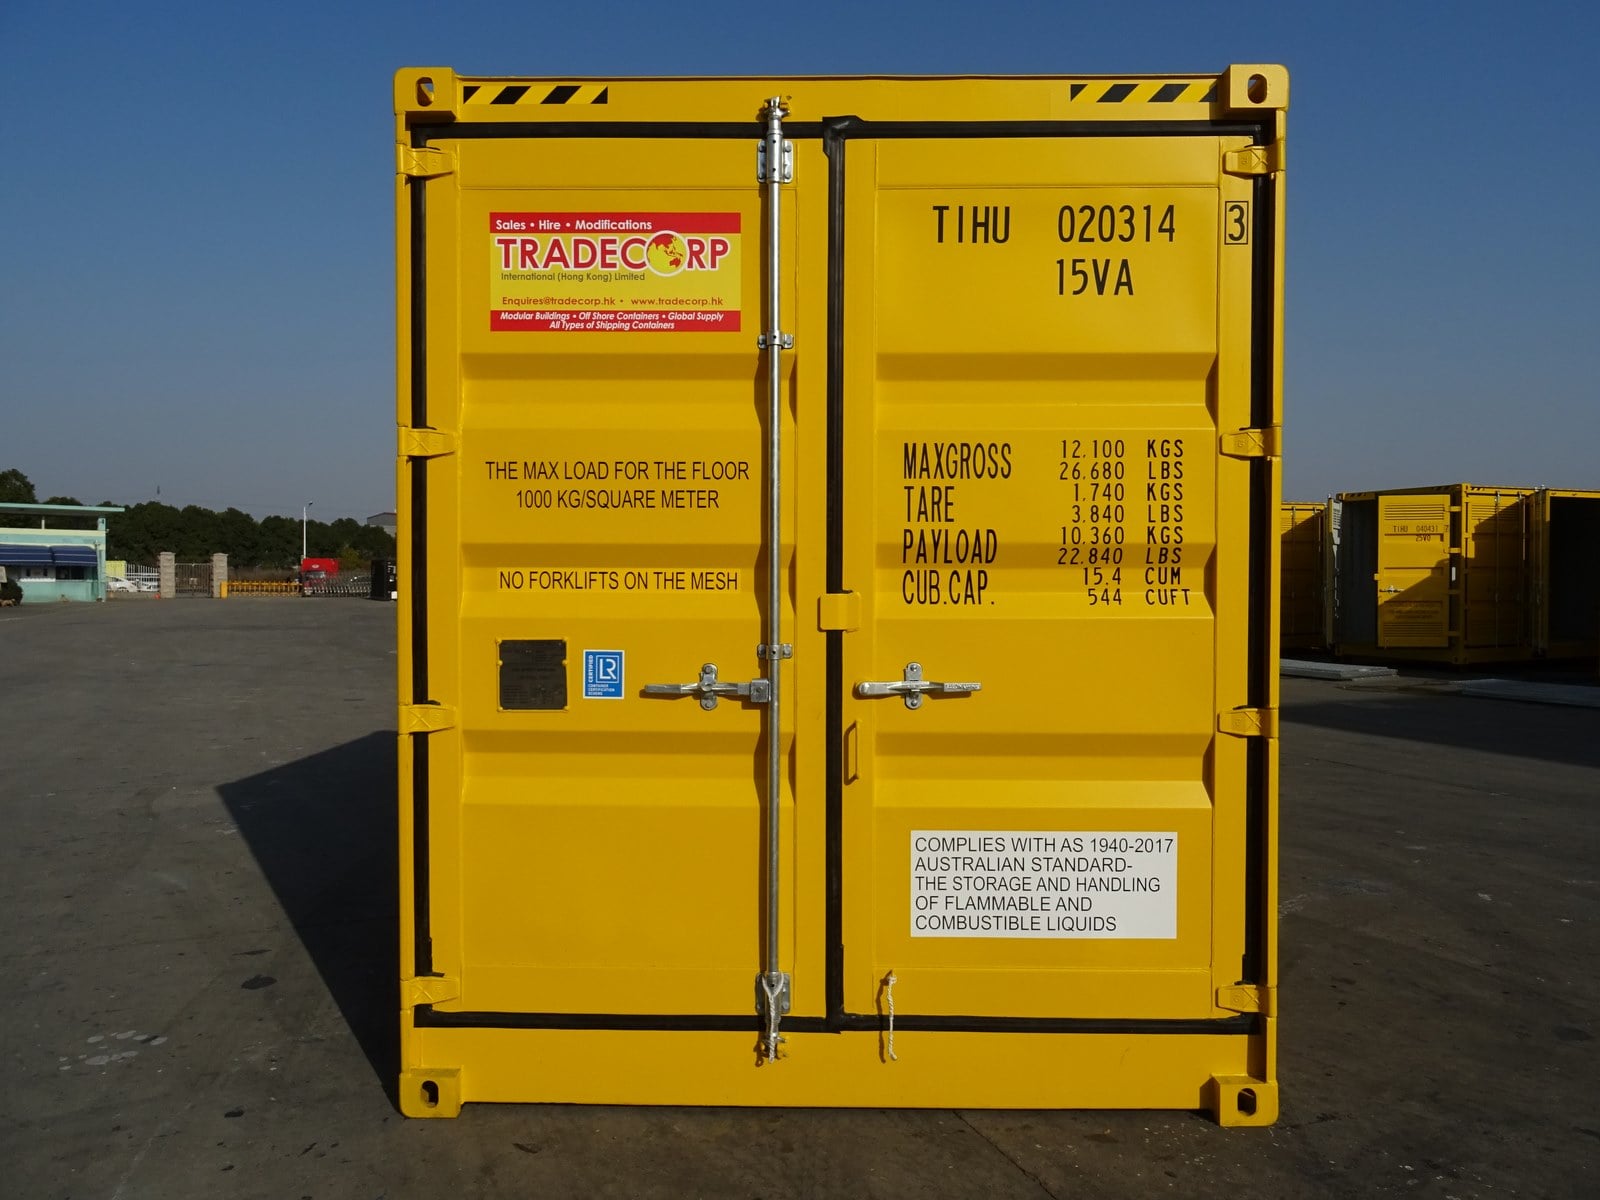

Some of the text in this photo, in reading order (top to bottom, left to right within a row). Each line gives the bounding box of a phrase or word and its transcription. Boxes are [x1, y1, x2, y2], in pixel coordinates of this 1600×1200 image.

[496, 220, 652, 230] Sales Hire Modifications
[933, 204, 1245, 243] TIHU 020314 3
[496, 230, 730, 277] TRADECORP
[558, 272, 584, 282] (Hong
[586, 272, 612, 282] Kong)
[1056, 259, 1134, 295] 15VA
[502, 297, 724, 307] Enquires@tradecorp.hk www.tradecorp.hk
[500, 312, 724, 322] Modular Buildings Off Shore Containers Global Supply
[549, 321, 675, 330] All Types of Shipping Containers
[1061, 440, 1125, 458] 12.100
[1147, 440, 1184, 458] KGS
[485, 461, 749, 480] THE MAX LOAD FOR THE FLOOR
[1060, 462, 1184, 480] 26.680 LBS
[516, 490, 719, 509] 1000 KG/SQUARE METER
[904, 483, 1184, 522] TARE 1.740 KGS
[1072, 505, 1184, 523] 3.840 LBS
[902, 526, 1184, 564] PAYLOAD 10.360 KGS
[1058, 548, 1182, 565] 22.840 LBS
[500, 571, 738, 590] NO FORKLIFTS ON THE MESH
[1084, 567, 1122, 585] 15.4
[1145, 567, 1181, 585] CUM
[1088, 589, 1190, 605] 544 CUFT
[600, 659, 616, 679] LR
[915, 837, 1173, 853] COMPLIES WITH AS 1940-2017
[915, 857, 1132, 872] AUSTRALIAN STANDARD-
[915, 876, 1160, 892] THE STORAGE AND HANDLING
[915, 896, 1092, 911] OF FLAMMABLE AND
[915, 915, 1117, 931] COMBUSTIBLE LIQUIDS
